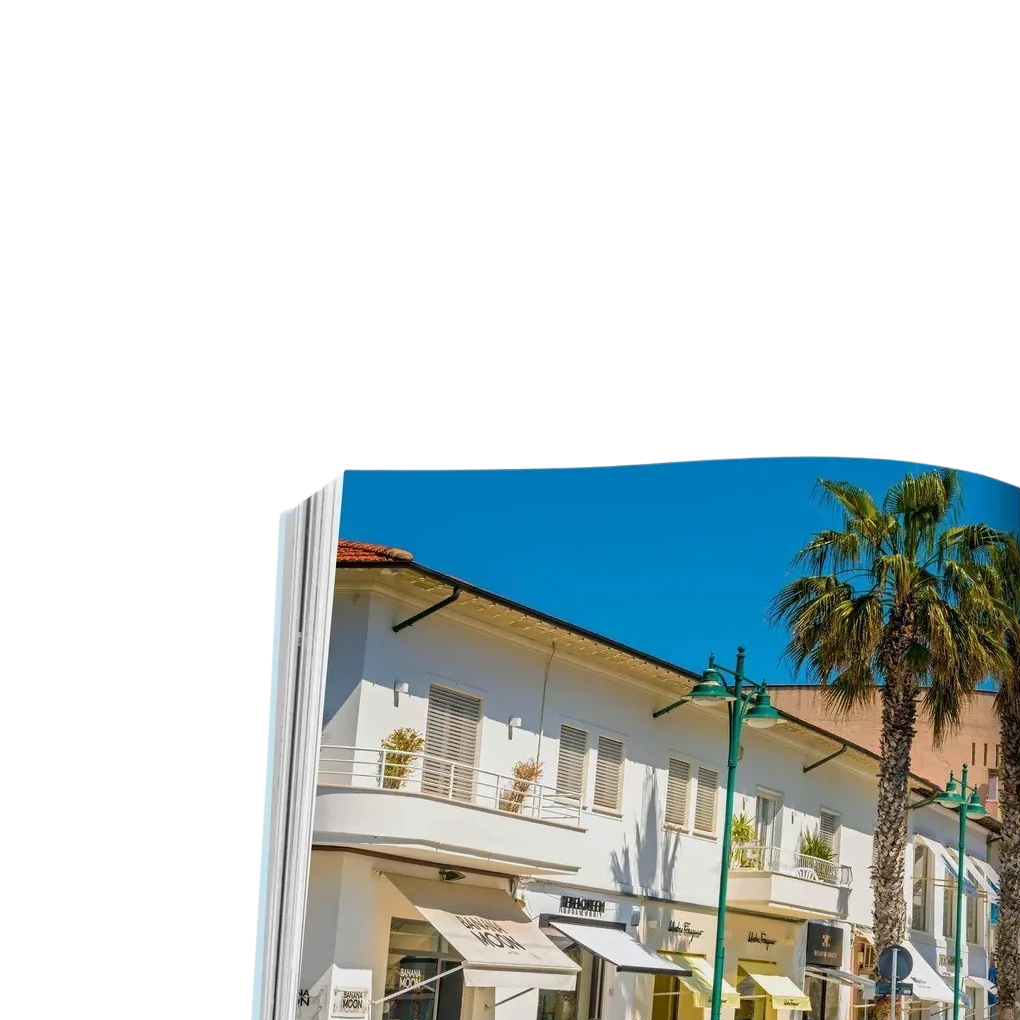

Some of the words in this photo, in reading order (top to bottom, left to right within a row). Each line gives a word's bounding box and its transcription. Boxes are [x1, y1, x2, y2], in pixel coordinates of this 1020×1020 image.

[456, 915, 508, 934] BANANA
[470, 930, 526, 950] MOON
[400, 968, 421, 977] BANANA
[343, 991, 363, 999] BANANA
[342, 999, 363, 1009] MOON
